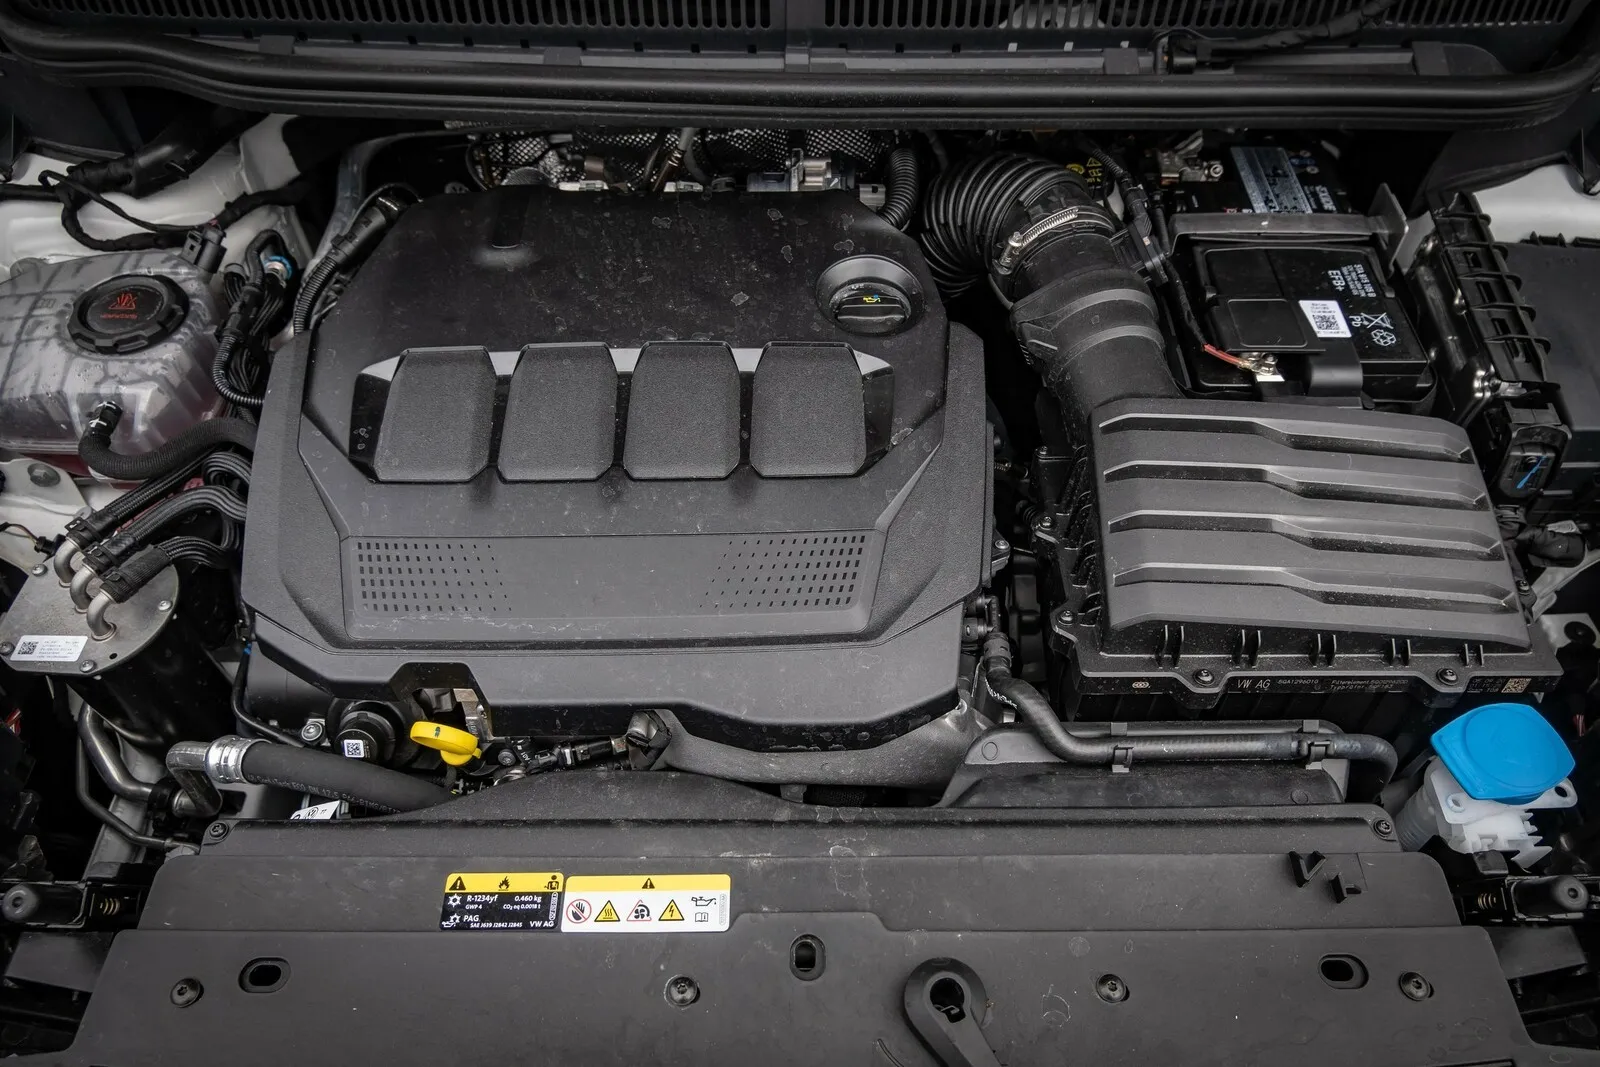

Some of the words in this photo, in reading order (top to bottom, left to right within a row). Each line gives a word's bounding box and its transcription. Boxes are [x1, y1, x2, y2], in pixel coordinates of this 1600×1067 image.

[1328, 270, 1346, 292] EFB+
[1348, 315, 1362, 327] Pb
[1237, 679, 1252, 688] VW
[1254, 679, 1271, 688] AG
[467, 895, 498, 903] R-1234yf
